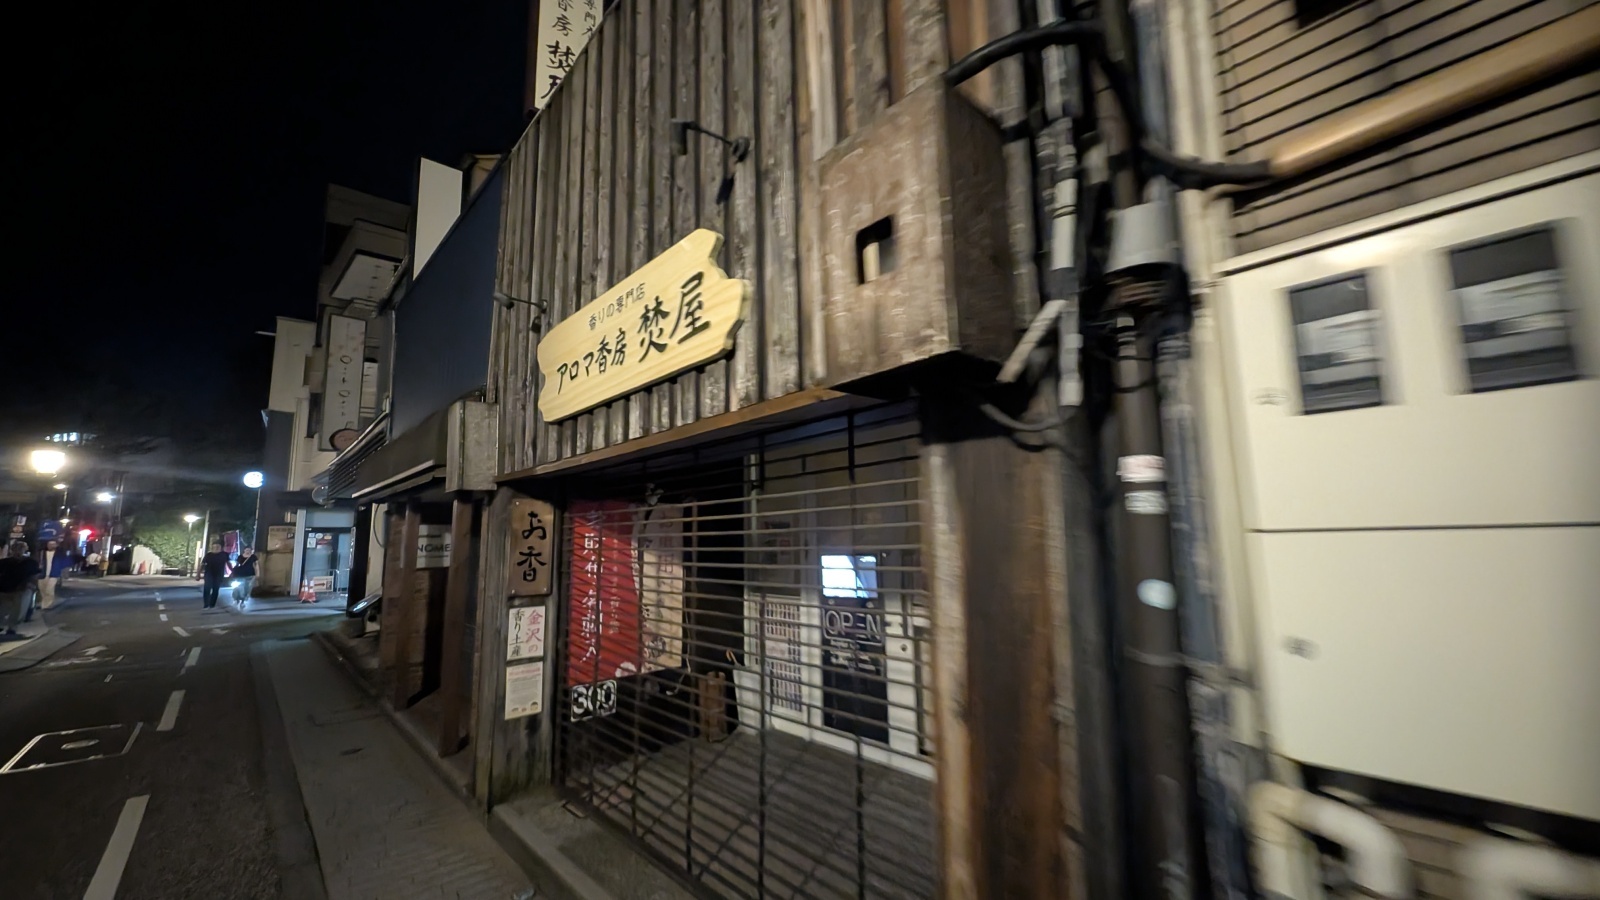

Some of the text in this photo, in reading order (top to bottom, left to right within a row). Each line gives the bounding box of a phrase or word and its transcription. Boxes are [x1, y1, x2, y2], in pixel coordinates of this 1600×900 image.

[588, 283, 645, 331] 香りの専門店
[517, 510, 547, 582] お香
[525, 609, 543, 653] 金沢の
[825, 610, 881, 642] OPEN
